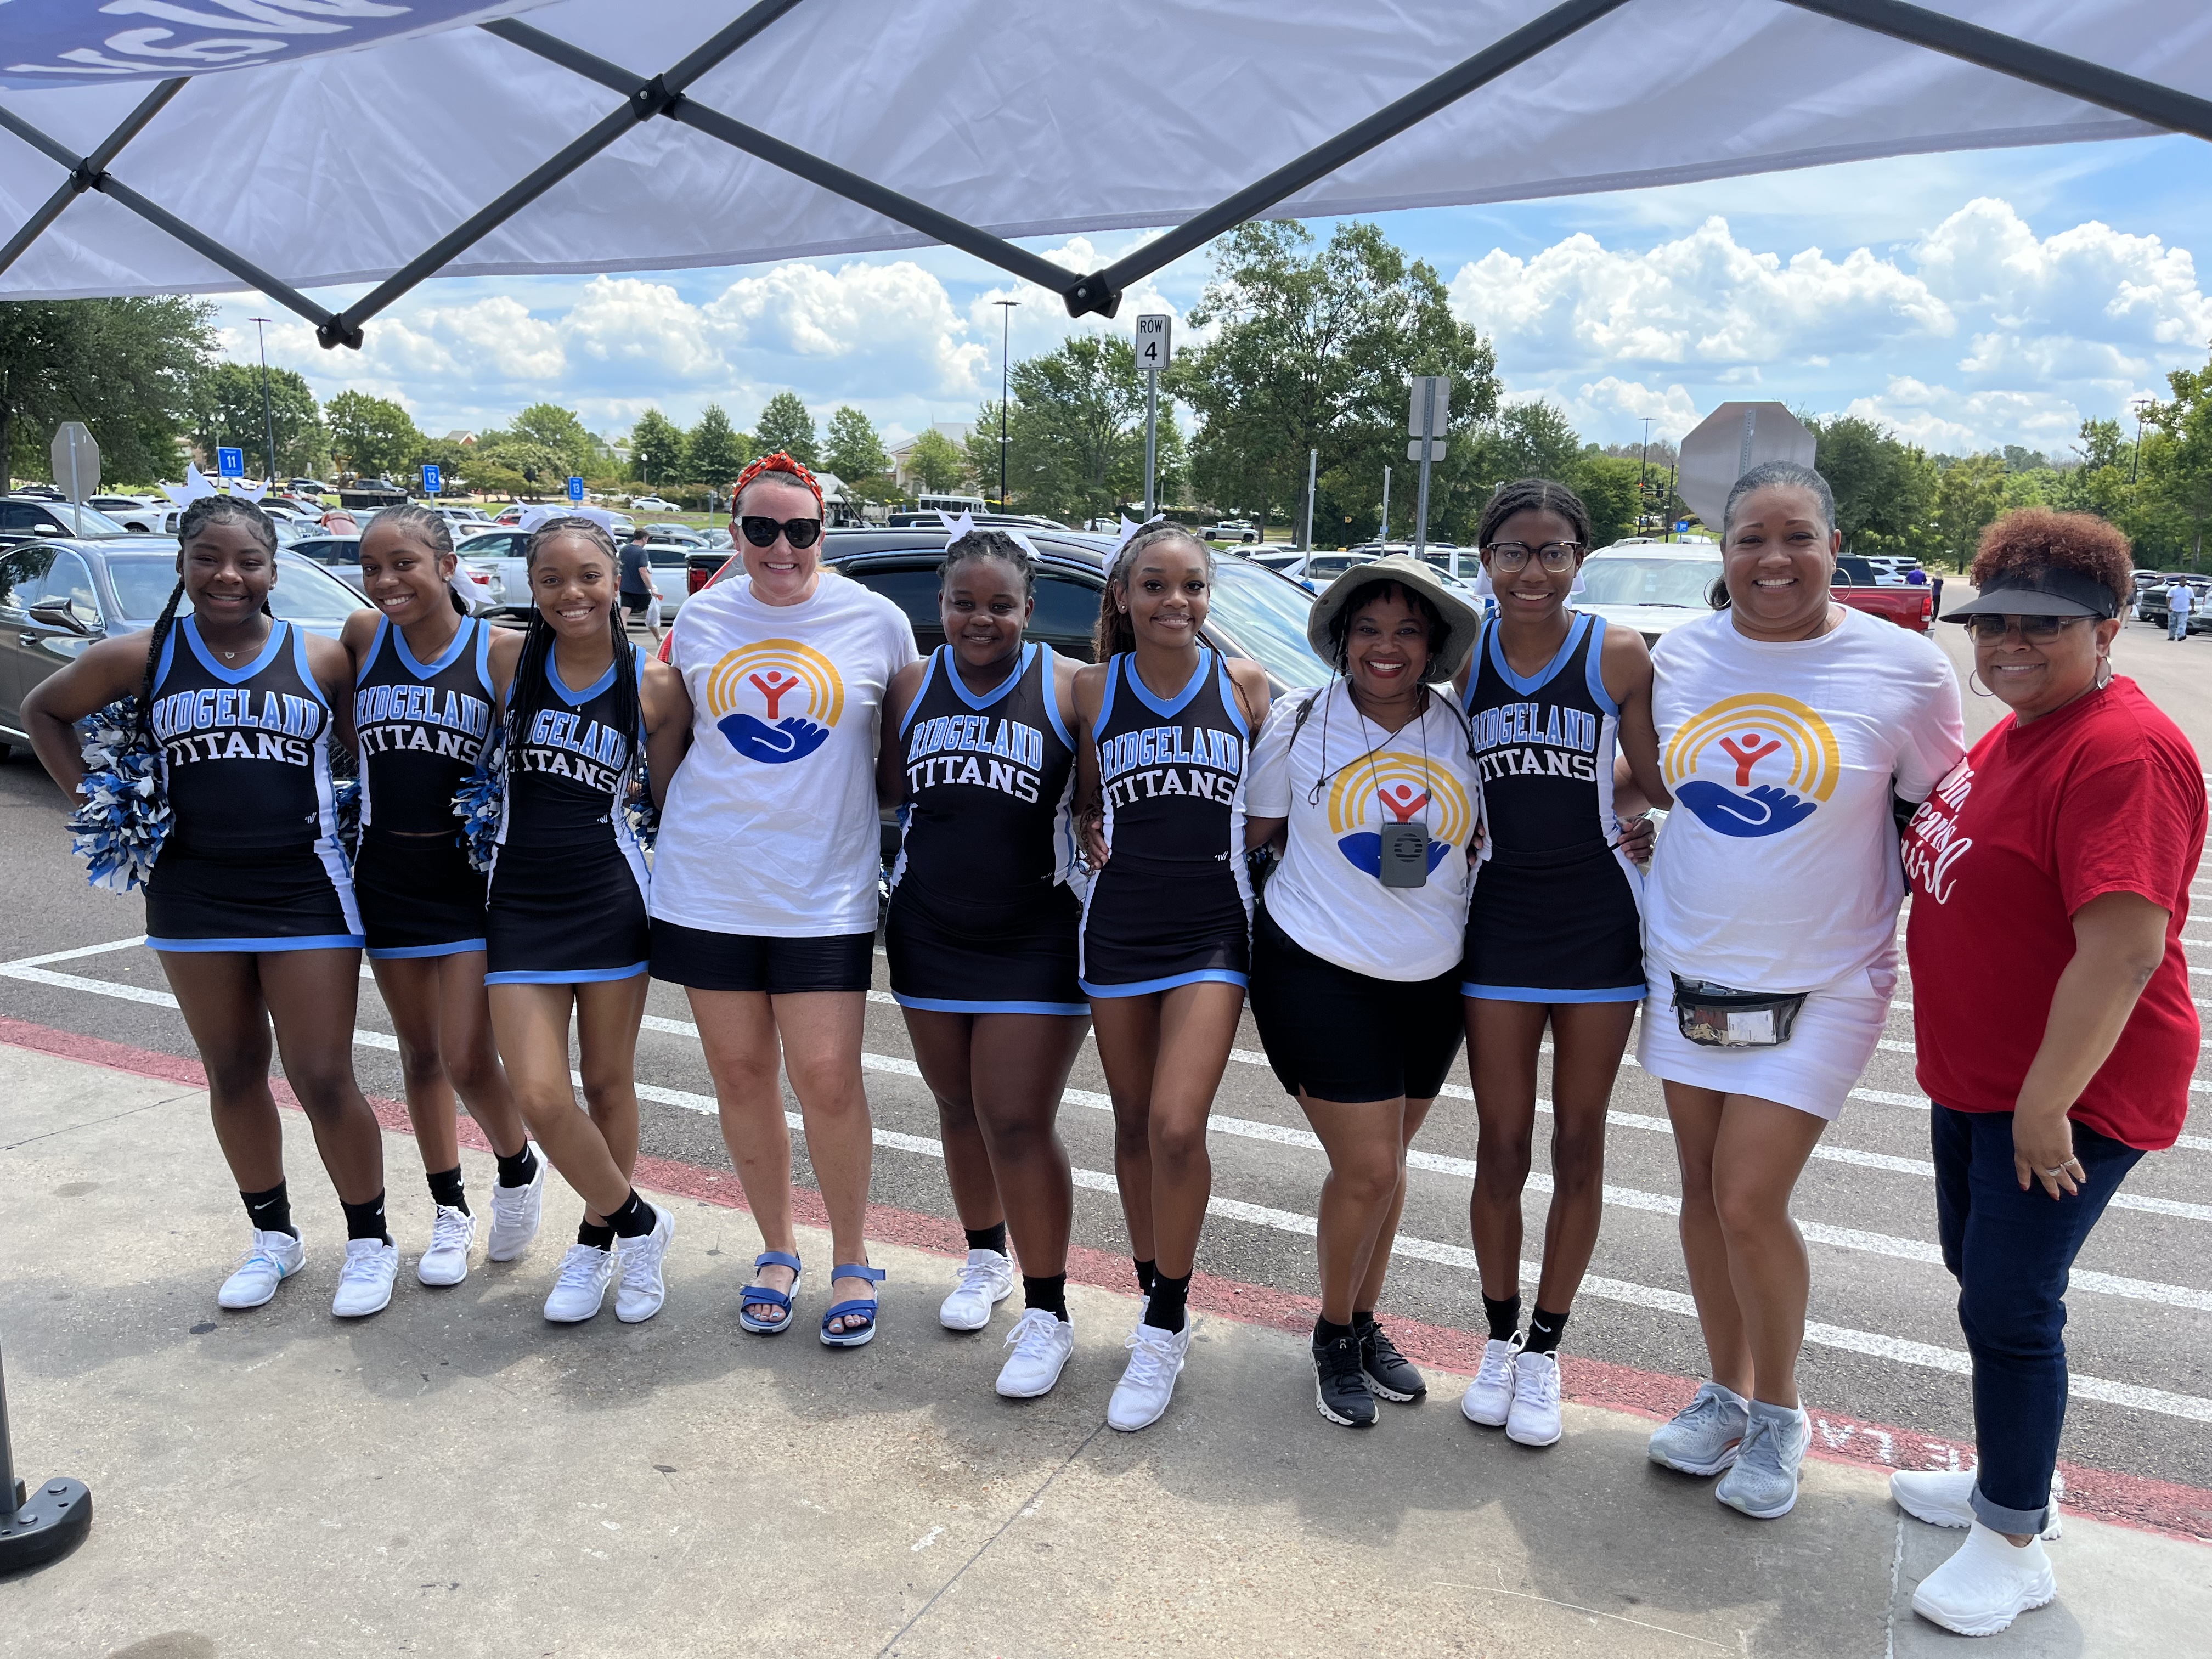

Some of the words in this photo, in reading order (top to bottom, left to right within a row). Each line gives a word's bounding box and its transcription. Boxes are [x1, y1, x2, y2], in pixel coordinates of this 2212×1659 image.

[1141, 320, 1163, 334] ROW
[1144, 342, 1158, 360] 4
[227, 455, 236, 468] 11
[428, 472, 436, 484] 12
[573, 483, 580, 494] 13
[153, 689, 320, 741] RIDGELAND
[357, 685, 489, 740] RIDGELAND
[1472, 703, 1596, 754] RIDGELAND
[167, 731, 308, 767] TITANS
[359, 725, 481, 766] TITANS
[506, 708, 629, 772] GELAND
[907, 715, 1043, 771] RIDGELAND
[1102, 726, 1240, 782] RIDGELAND
[907, 755, 1041, 804] TITANS
[1479, 748, 1596, 782] TITANS
[1109, 768, 1237, 808] TITANS
[1909, 802, 1959, 853] earls
